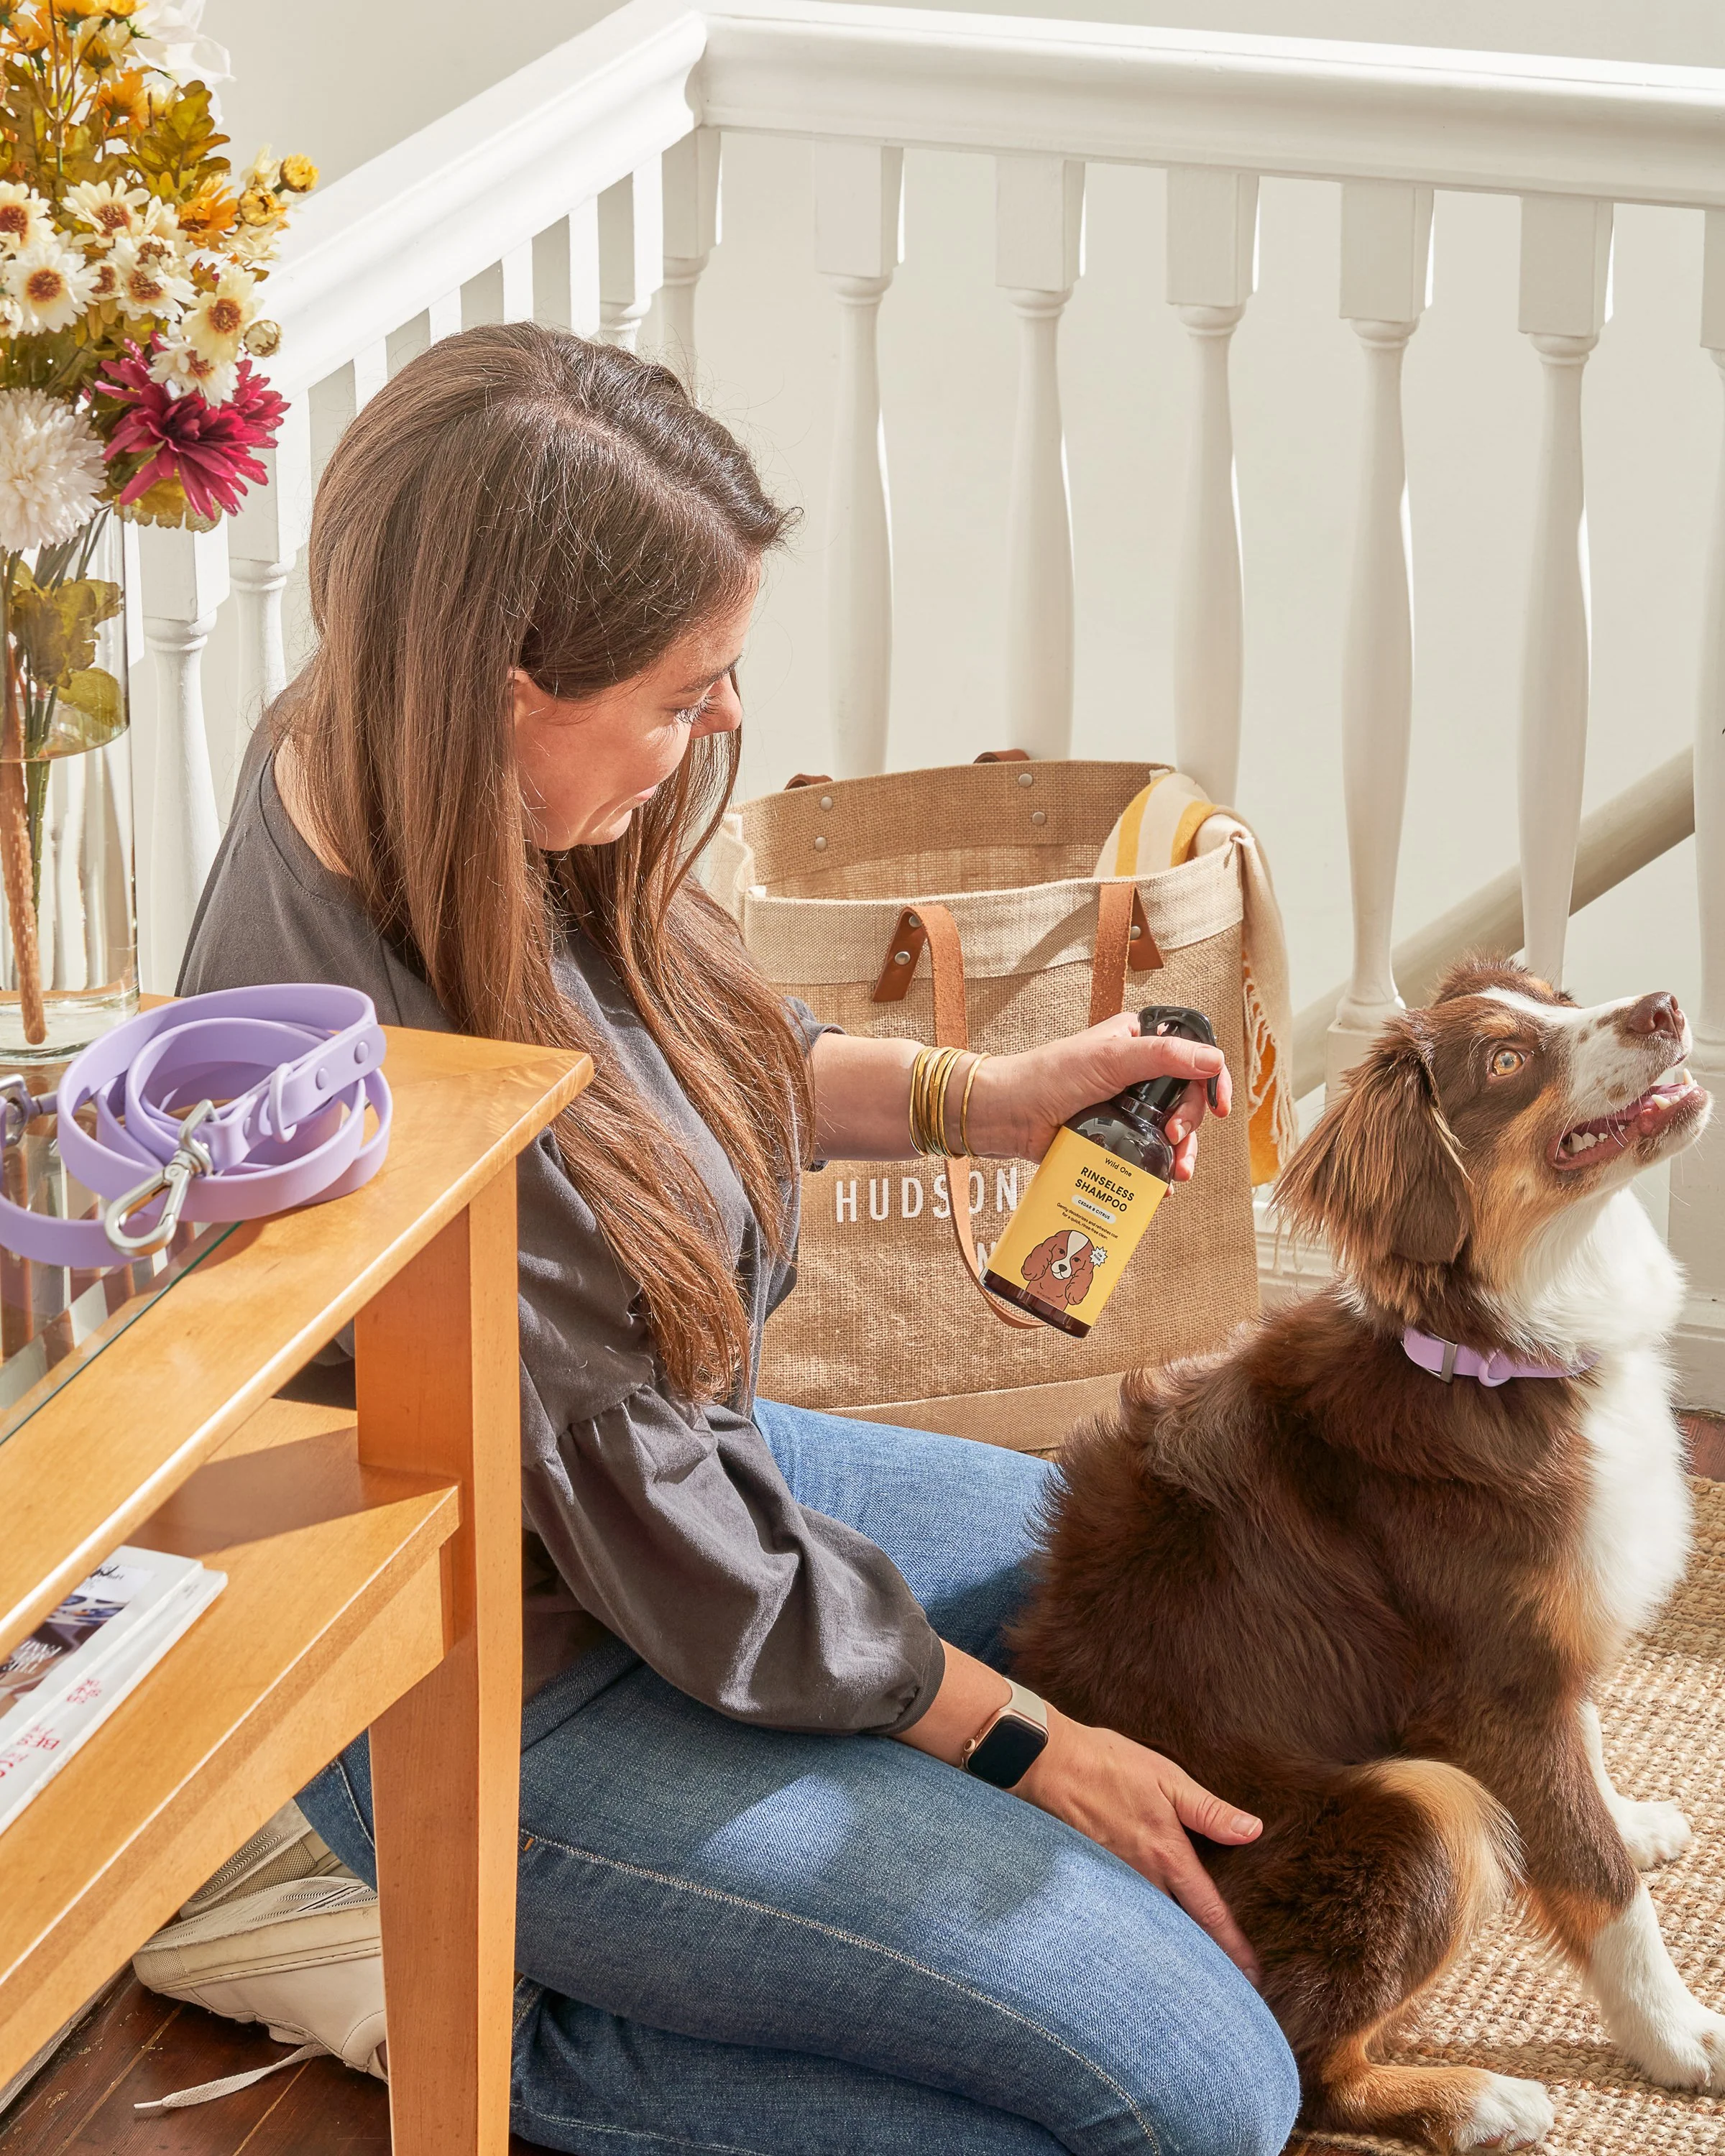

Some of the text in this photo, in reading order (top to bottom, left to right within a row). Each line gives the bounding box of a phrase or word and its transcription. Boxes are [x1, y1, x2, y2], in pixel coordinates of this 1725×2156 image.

[1080, 1166, 1134, 1201] RINSELESS
[1105, 1158, 1132, 1177] Wild One
[836, 1167, 1018, 1222] HUDSON
[1075, 1179, 1127, 1212] SHAMPOO
[1078, 1199, 1092, 1210] CEDAR
[1095, 1210, 1110, 1220] CITRUS
[1057, 1202, 1069, 1212] Gently
[1069, 1210, 1088, 1222] deodorizes
[1095, 1225, 1111, 1235] refreshes
